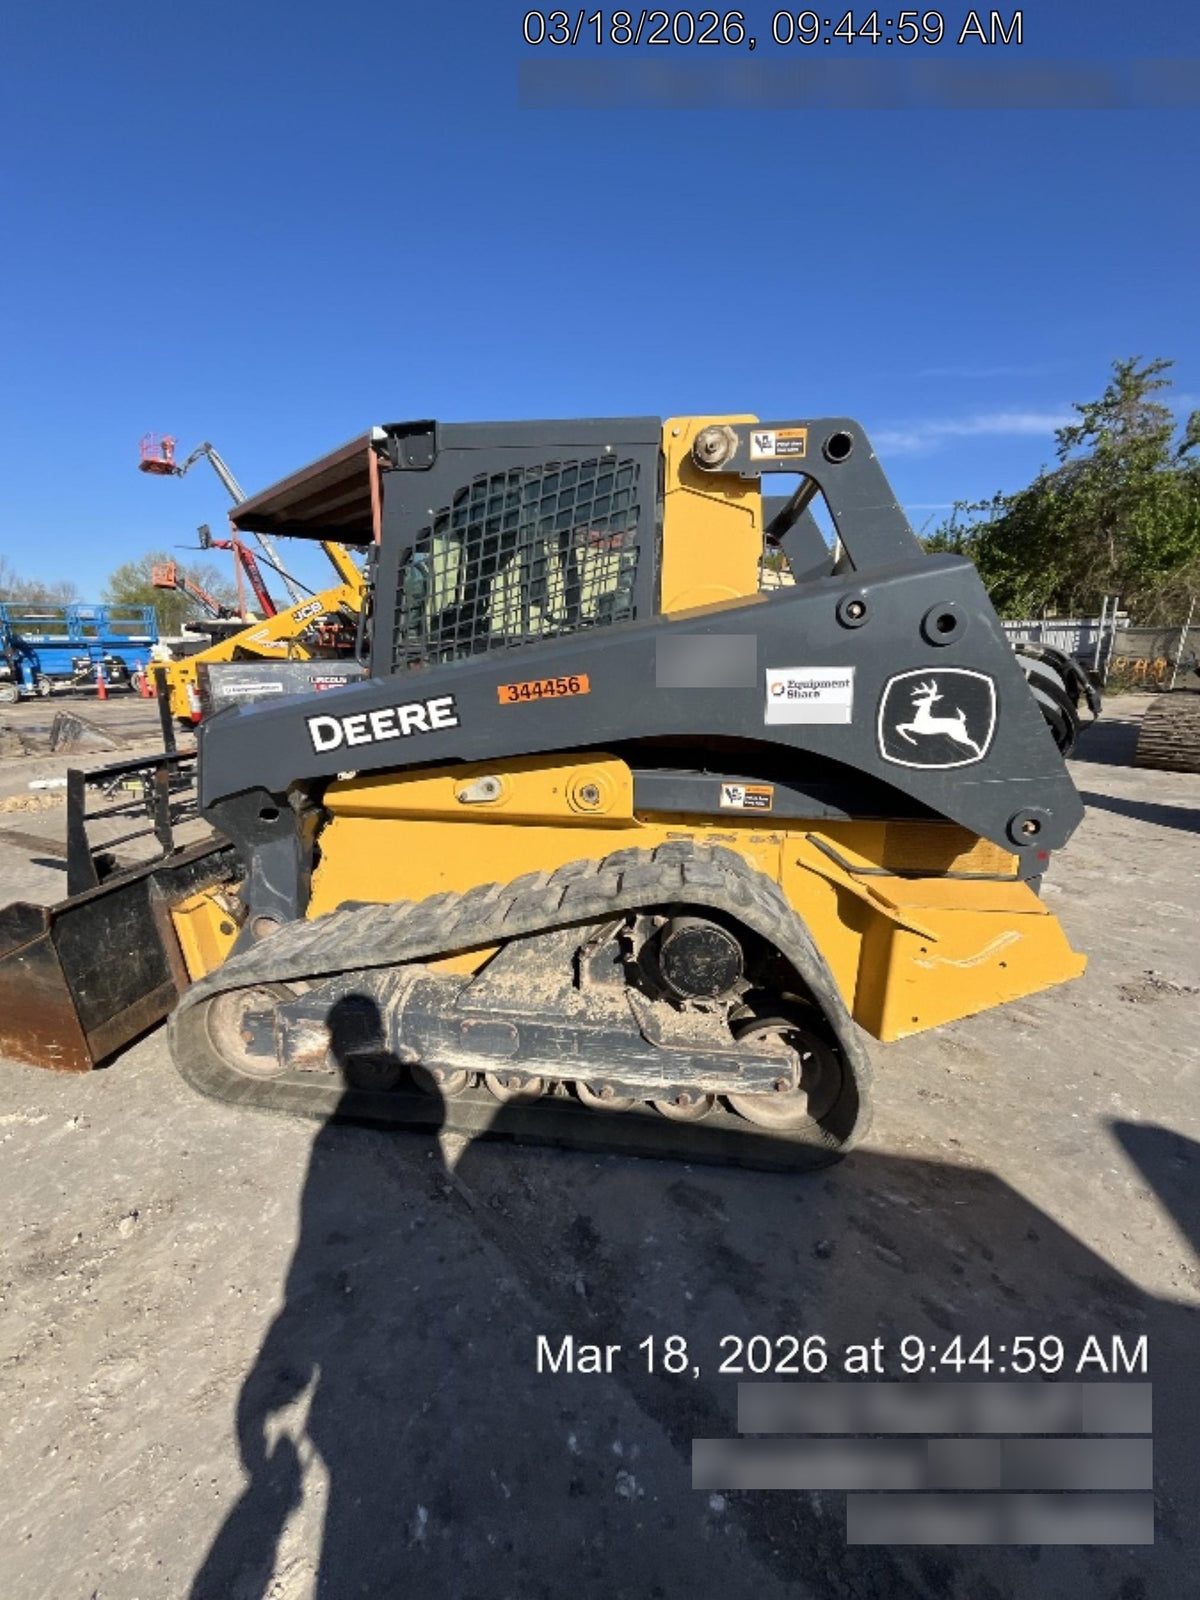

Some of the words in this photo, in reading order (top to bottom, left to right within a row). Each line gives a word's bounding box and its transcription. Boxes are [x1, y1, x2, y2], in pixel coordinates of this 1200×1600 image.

[293, 601, 323, 622] JCB
[507, 676, 581, 701] 344456
[787, 679, 850, 690] Equipment
[787, 690, 820, 699] Share
[307, 696, 458, 753] DEERE
